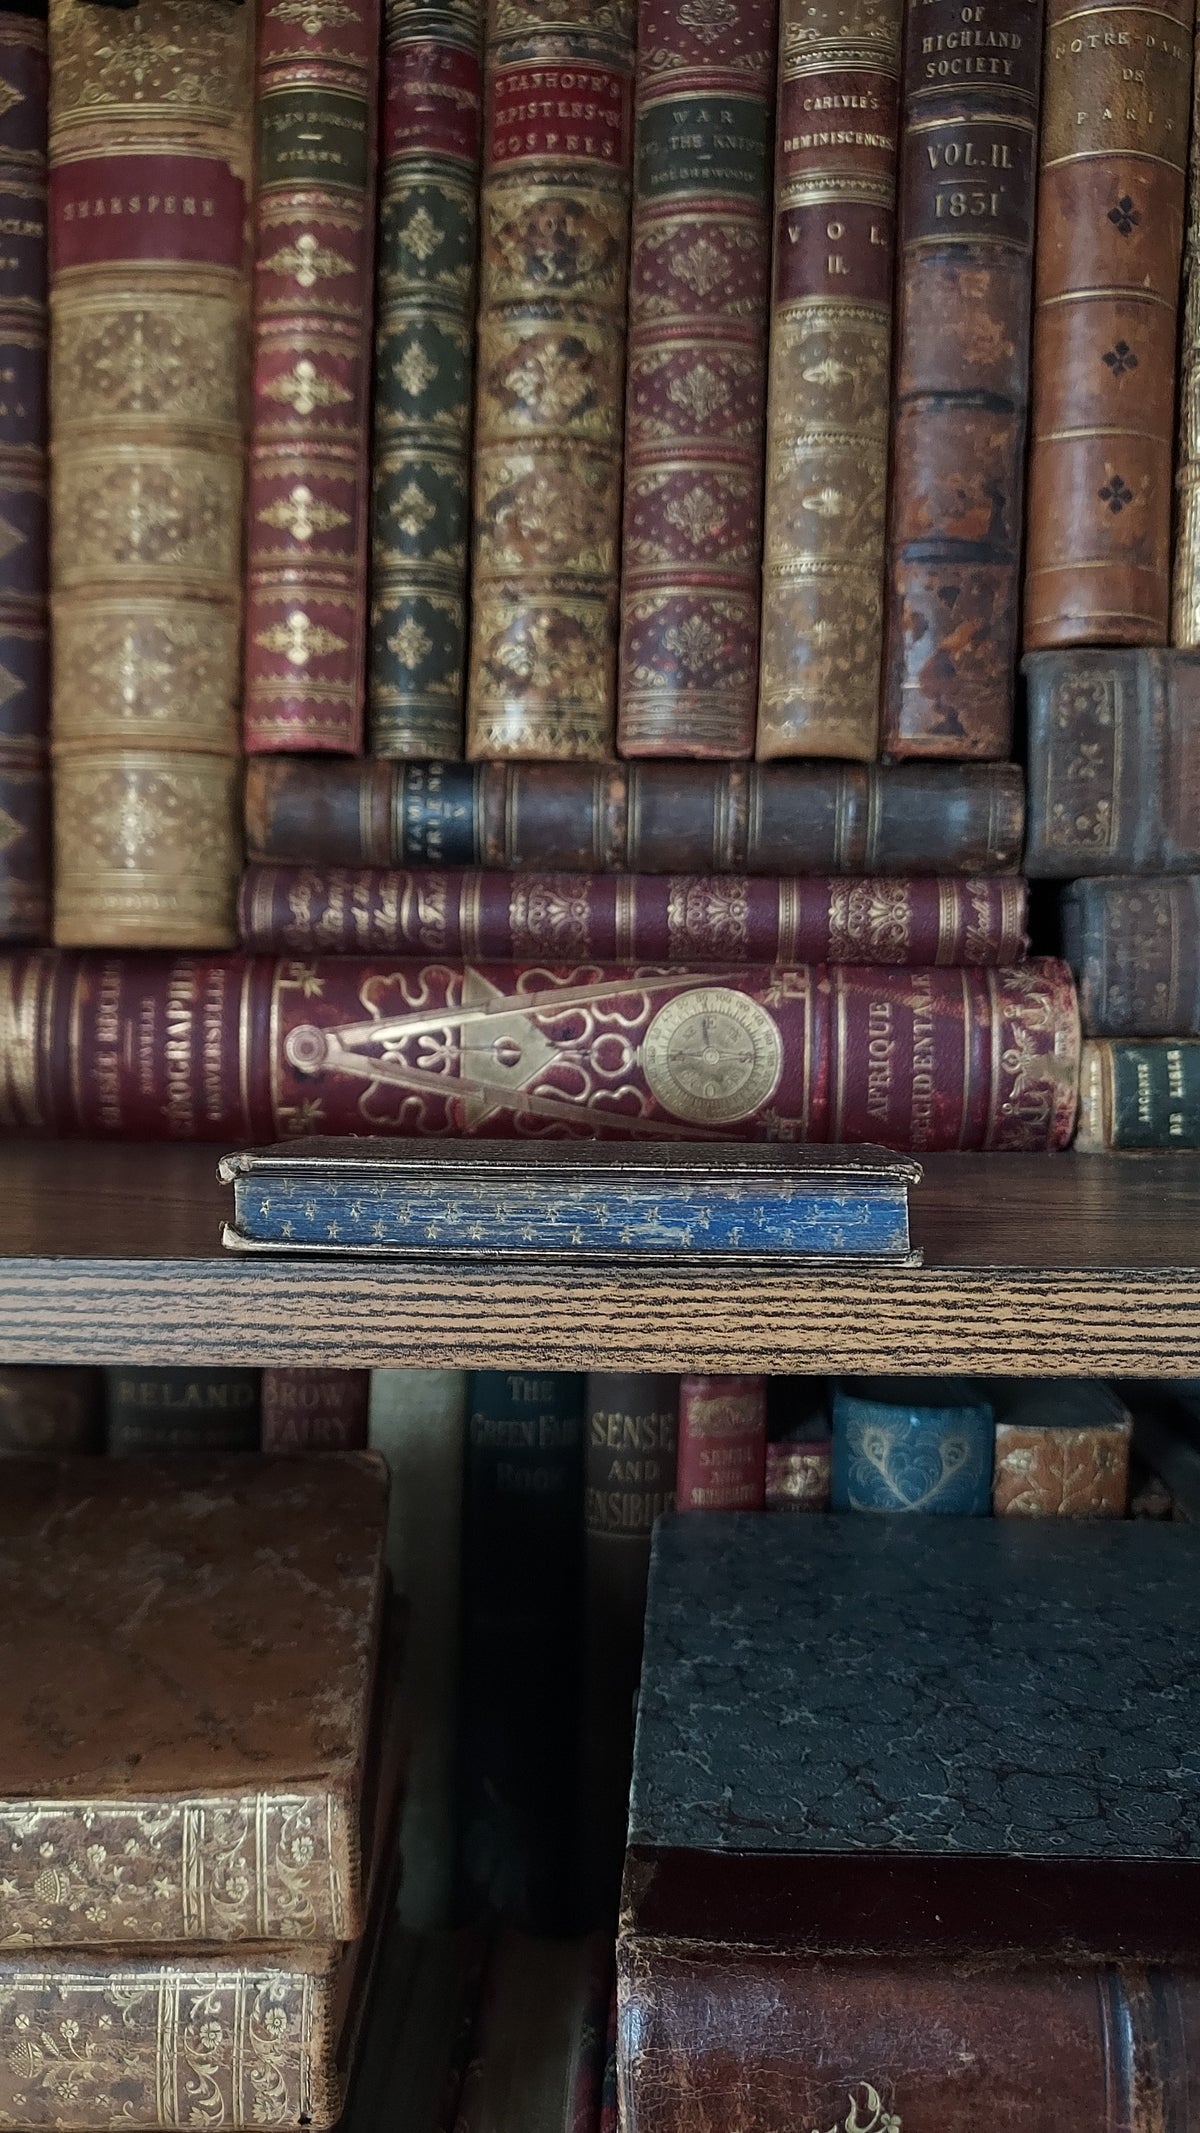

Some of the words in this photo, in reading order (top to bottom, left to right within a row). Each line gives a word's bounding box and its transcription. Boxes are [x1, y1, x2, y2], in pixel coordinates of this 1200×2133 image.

[961, 6, 985, 22] OF
[922, 30, 1021, 54] HIGHLAND
[925, 57, 1014, 78] SOCIETY
[803, 90, 880, 112] CARLYLE'S
[672, 109, 735, 124] WAR
[867, 1001, 895, 1122] AFRIQUE
[591, 1410, 675, 1452] SENSE
[607, 1459, 661, 1482] AND
